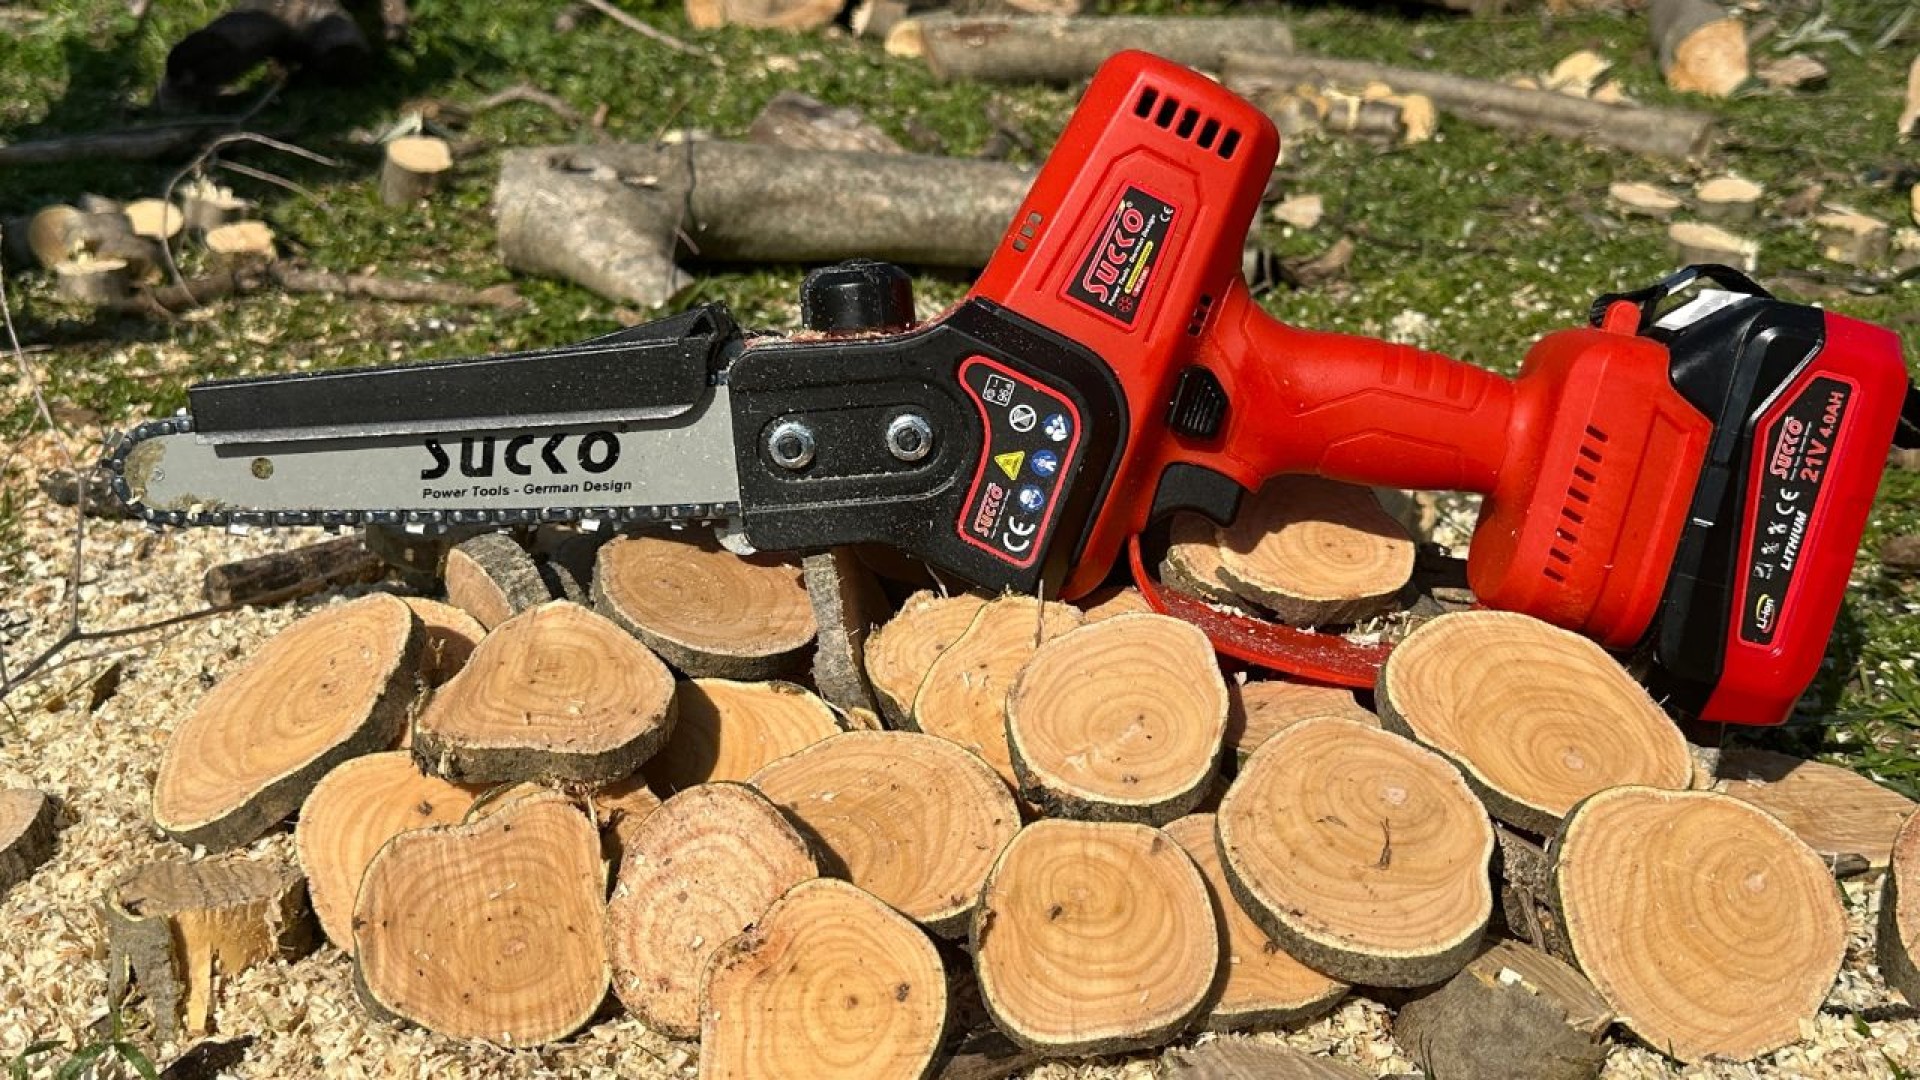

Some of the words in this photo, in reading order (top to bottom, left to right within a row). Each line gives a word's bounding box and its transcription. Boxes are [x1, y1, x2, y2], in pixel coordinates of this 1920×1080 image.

[1800, 438, 1827, 483] 21V
[1819, 391, 1844, 438] 4.0AH
[422, 487, 467, 499] Power
[472, 485, 510, 497] Tools
[523, 483, 579, 495] German
[583, 480, 632, 494] Design
[1775, 488, 1800, 515] CE
[1003, 516, 1036, 552] CE
[1780, 510, 1807, 571] LITHIUM
